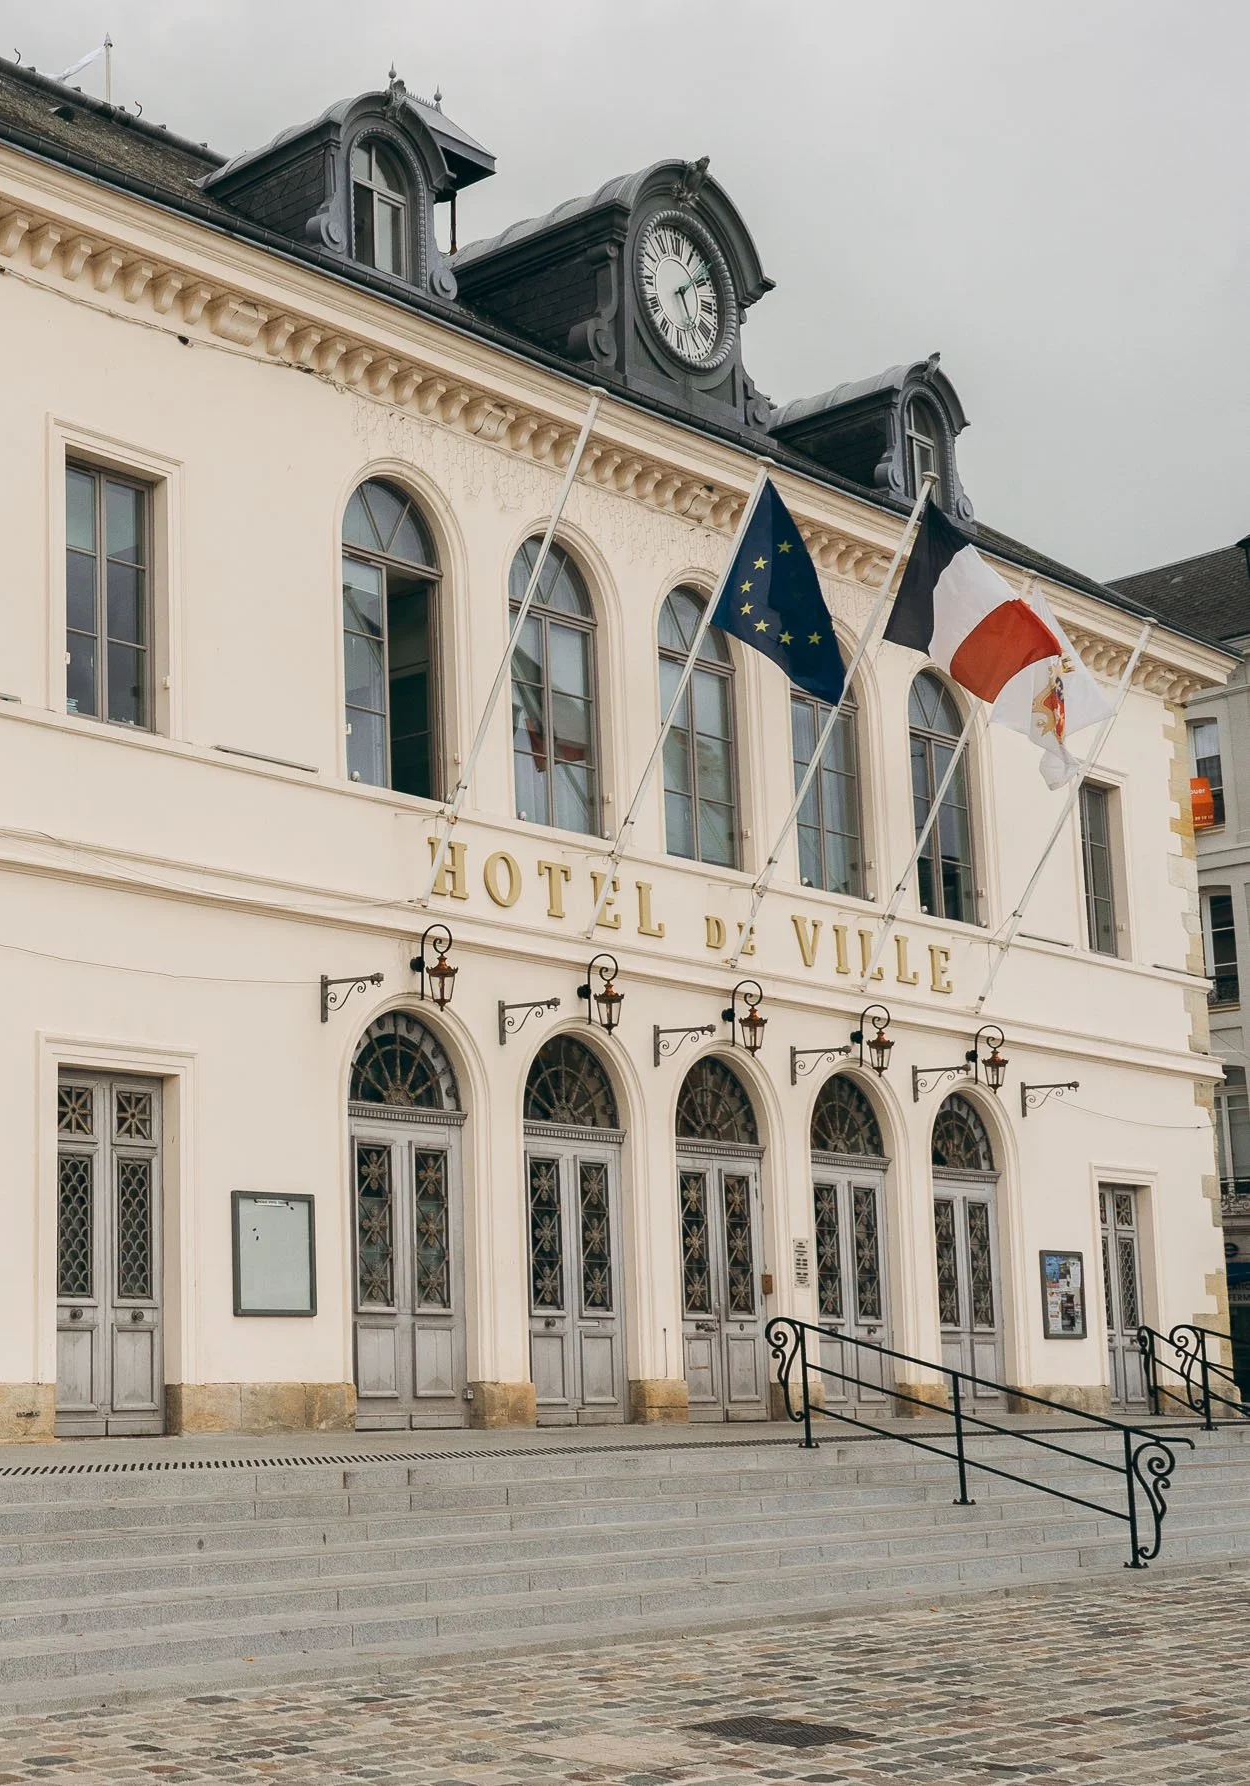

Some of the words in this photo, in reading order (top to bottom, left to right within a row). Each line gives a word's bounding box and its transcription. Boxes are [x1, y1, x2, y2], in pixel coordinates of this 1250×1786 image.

[427, 836, 666, 938] HOTEL
[704, 915, 756, 956] DE
[790, 914, 954, 993] VILLE
